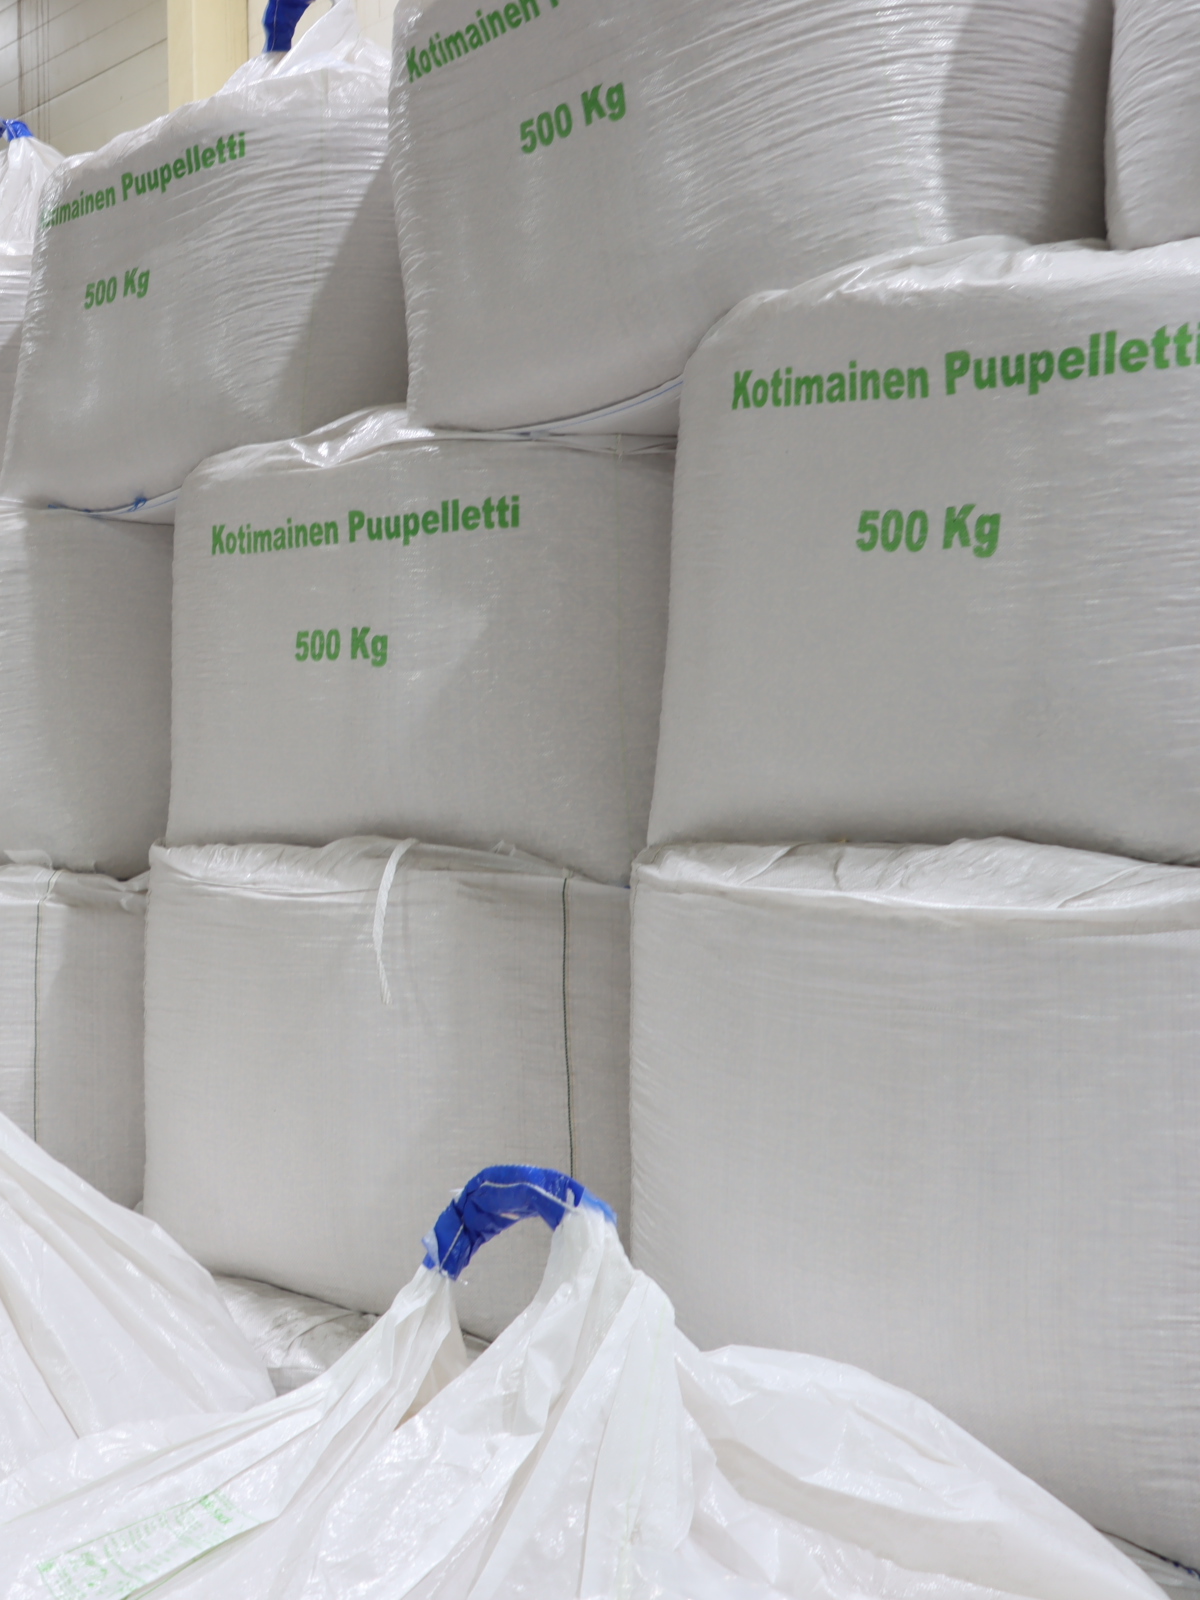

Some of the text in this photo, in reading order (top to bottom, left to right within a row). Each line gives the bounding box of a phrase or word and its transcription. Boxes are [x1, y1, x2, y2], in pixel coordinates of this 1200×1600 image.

[406, 0, 541, 83] Kotimainen
[520, 83, 627, 154] 500 Kg
[121, 131, 246, 203] Puupelletti
[84, 267, 151, 310] 500 Kg
[732, 360, 930, 411] Kotimainen
[211, 495, 521, 555] Kotimainen Puupelletti
[856, 503, 1002, 559] 500 Kg
[295, 626, 389, 668] 500 Kg
